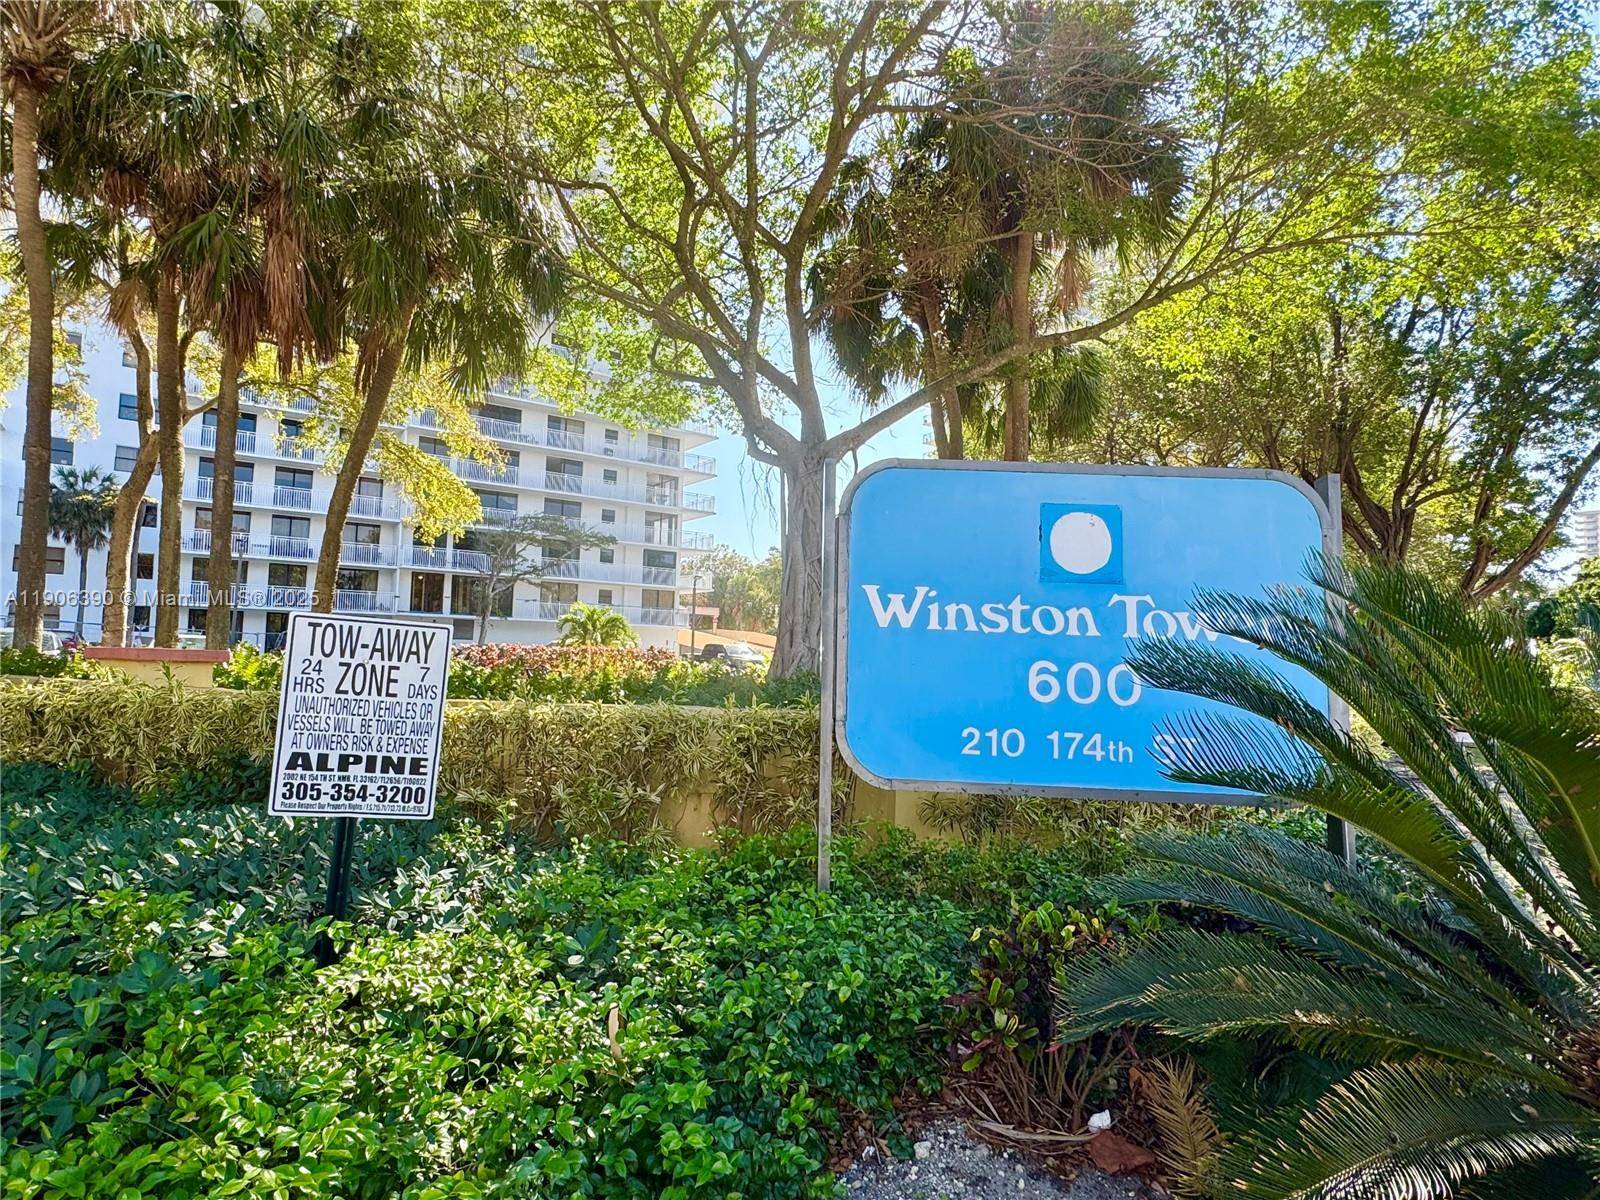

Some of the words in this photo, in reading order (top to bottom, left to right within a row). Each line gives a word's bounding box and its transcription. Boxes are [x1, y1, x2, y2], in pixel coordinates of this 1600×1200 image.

[861, 585, 1101, 637] Winston
[1107, 593, 1305, 643] Tow
[307, 622, 436, 664] TOW-AWAY
[301, 658, 323, 675] 24
[419, 666, 430, 682] 7
[293, 677, 325, 694] HRS
[335, 662, 400, 698] ZONE
[408, 683, 438, 700] DAYS
[1028, 660, 1142, 707] 600
[294, 695, 370, 717] UNAUTHORIZED
[372, 699, 417, 720] VEHICLES
[420, 702, 433, 720] OR
[288, 714, 330, 733] VESSELS
[333, 716, 355, 734] WILL
[360, 718, 372, 735] BE
[375, 719, 407, 736] TOWED
[409, 721, 435, 738] AWAY
[291, 732, 304, 749] AT
[306, 732, 349, 751] OWNERS
[351, 734, 374, 752] RISK
[376, 736, 383, 753] &
[386, 736, 428, 755] EXPENSE
[961, 727, 1025, 757] 210
[1047, 731, 1134, 763] 174th
[284, 751, 428, 776] ALPINE
[280, 801, 296, 809] Please
[281, 781, 426, 805] 305-354-3200
